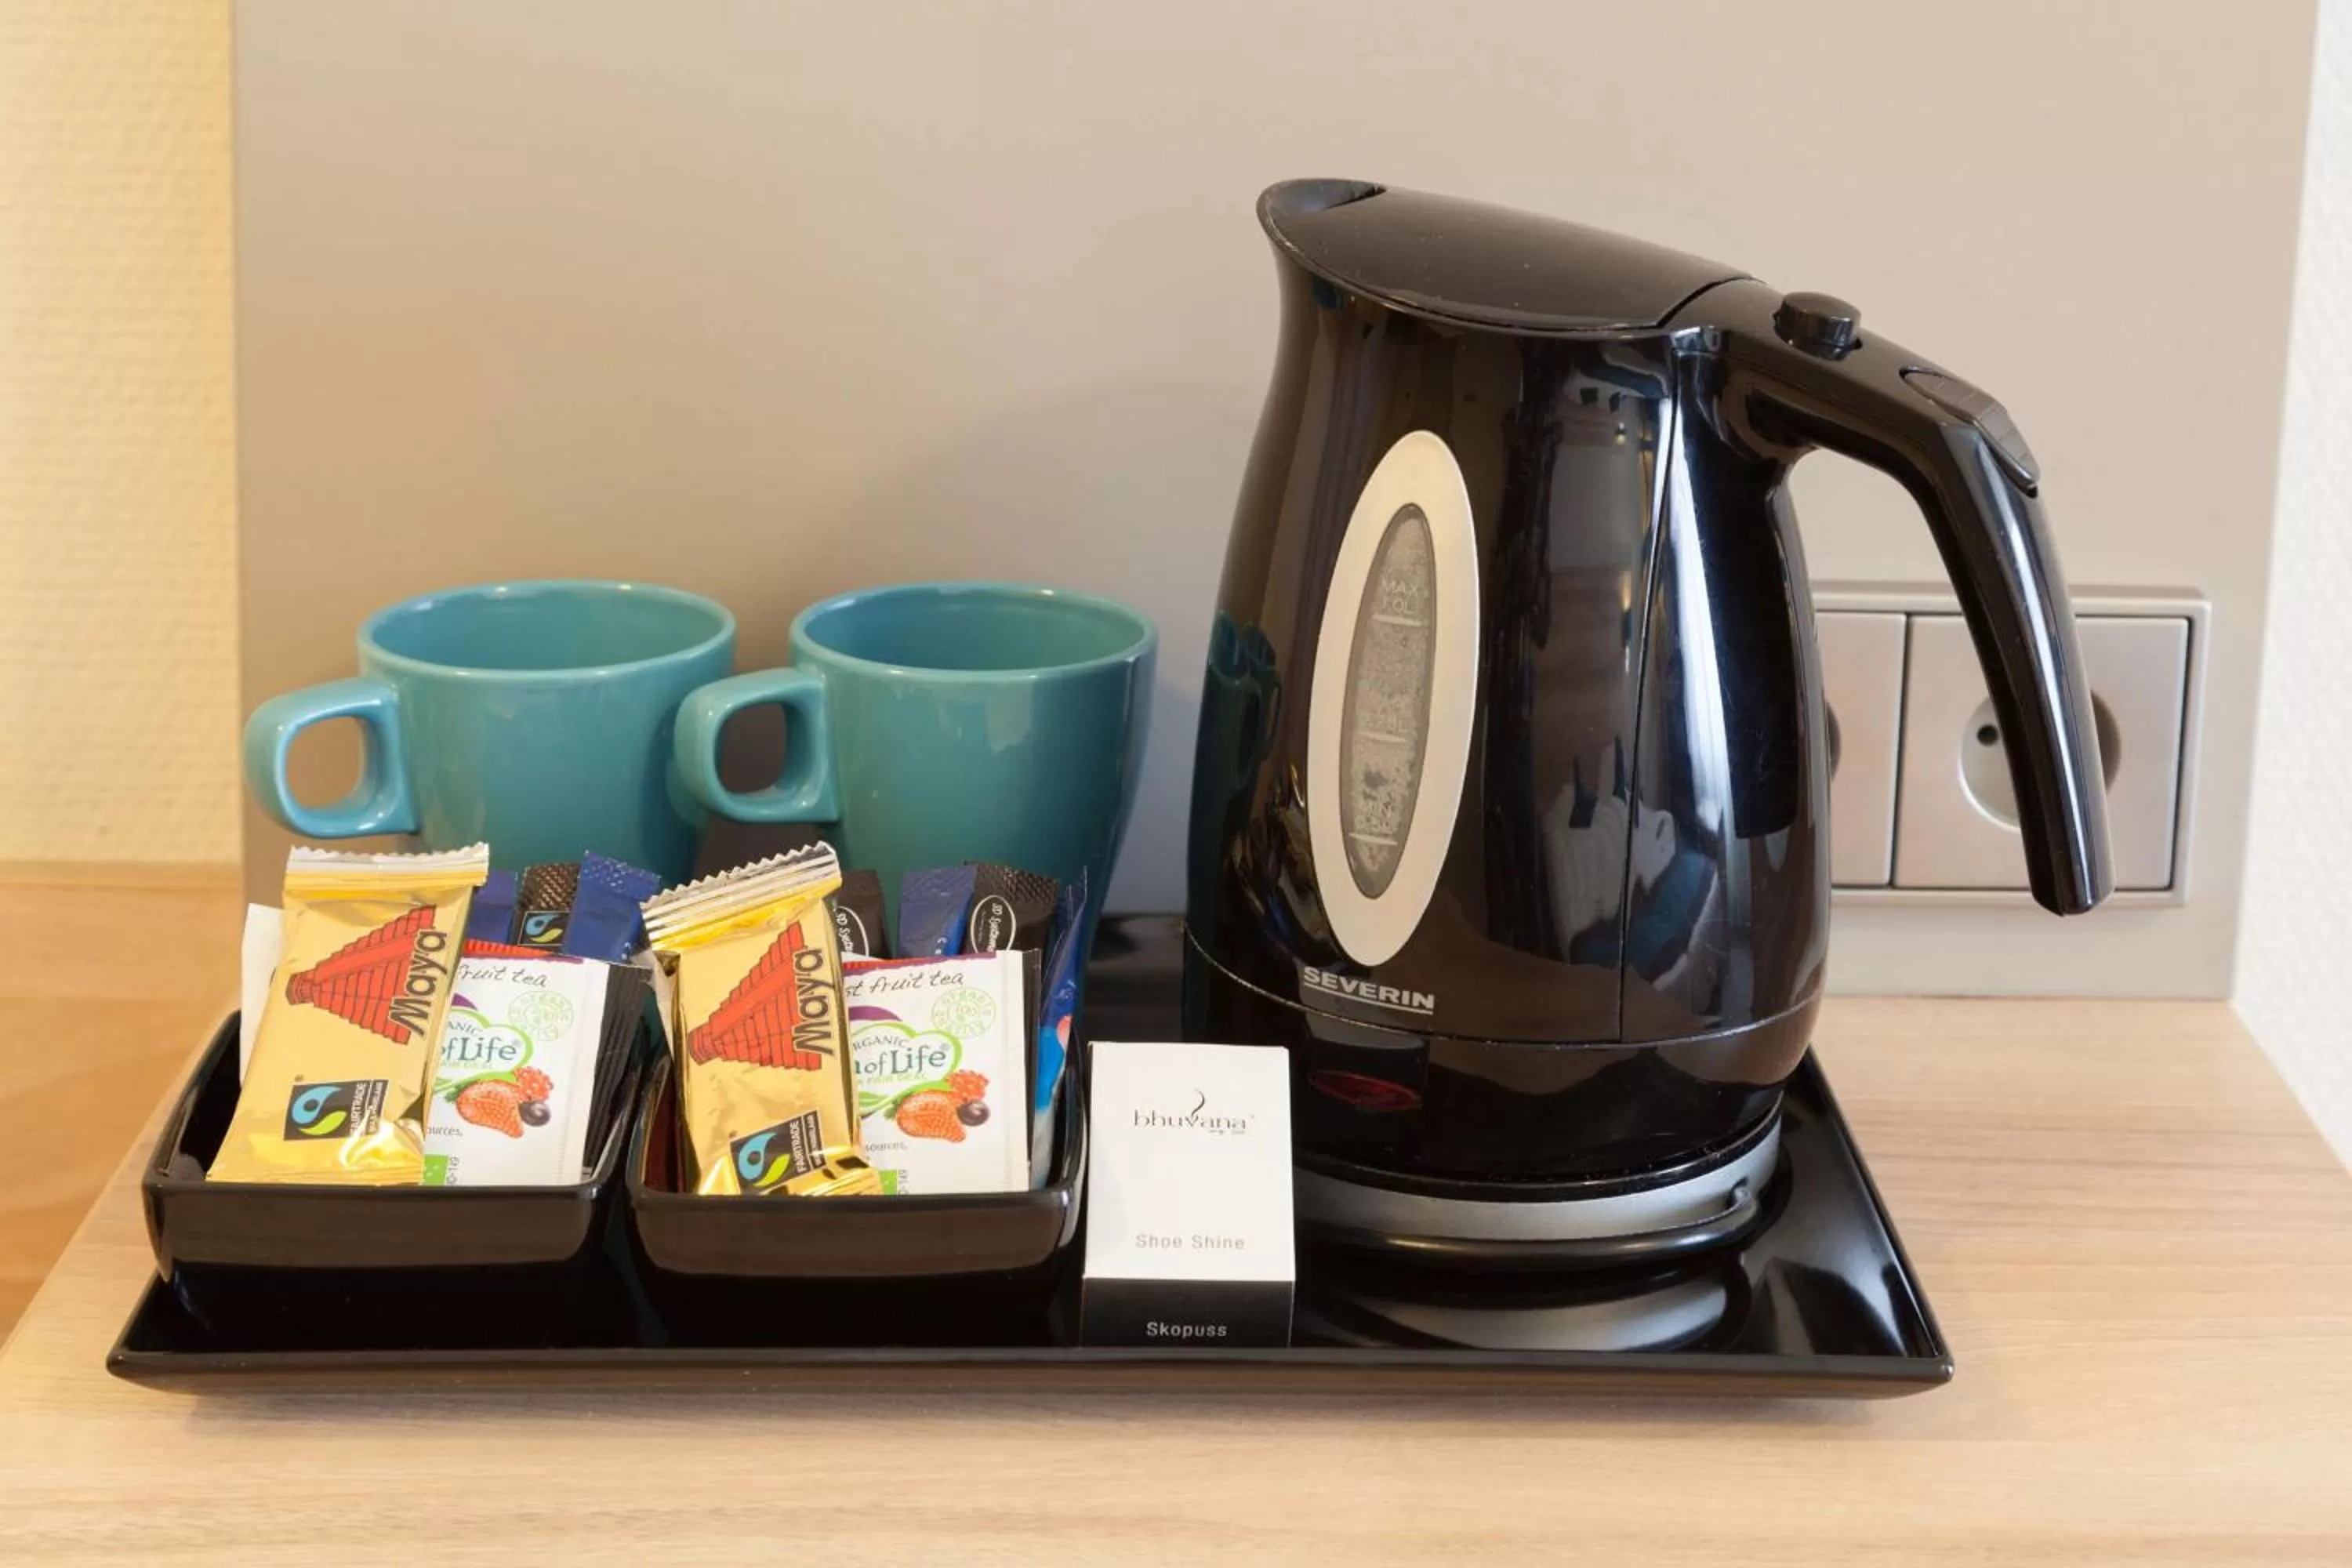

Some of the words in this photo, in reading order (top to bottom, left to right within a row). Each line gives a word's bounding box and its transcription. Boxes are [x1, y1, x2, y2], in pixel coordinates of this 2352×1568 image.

[390, 931, 448, 1036] Maya
[512, 968, 547, 988] tea
[869, 972, 924, 993] fruit
[930, 971, 964, 986] tea
[1304, 966, 1435, 1010] SEVERIN
[793, 949, 836, 1055] Maya
[853, 1035, 909, 1052] RGANIC
[789, 1120, 807, 1174] FAIRTRADE
[1135, 1233, 1183, 1250] Shoe
[1191, 1233, 1246, 1250] Shine
[1146, 1321, 1228, 1339] Skopuss
